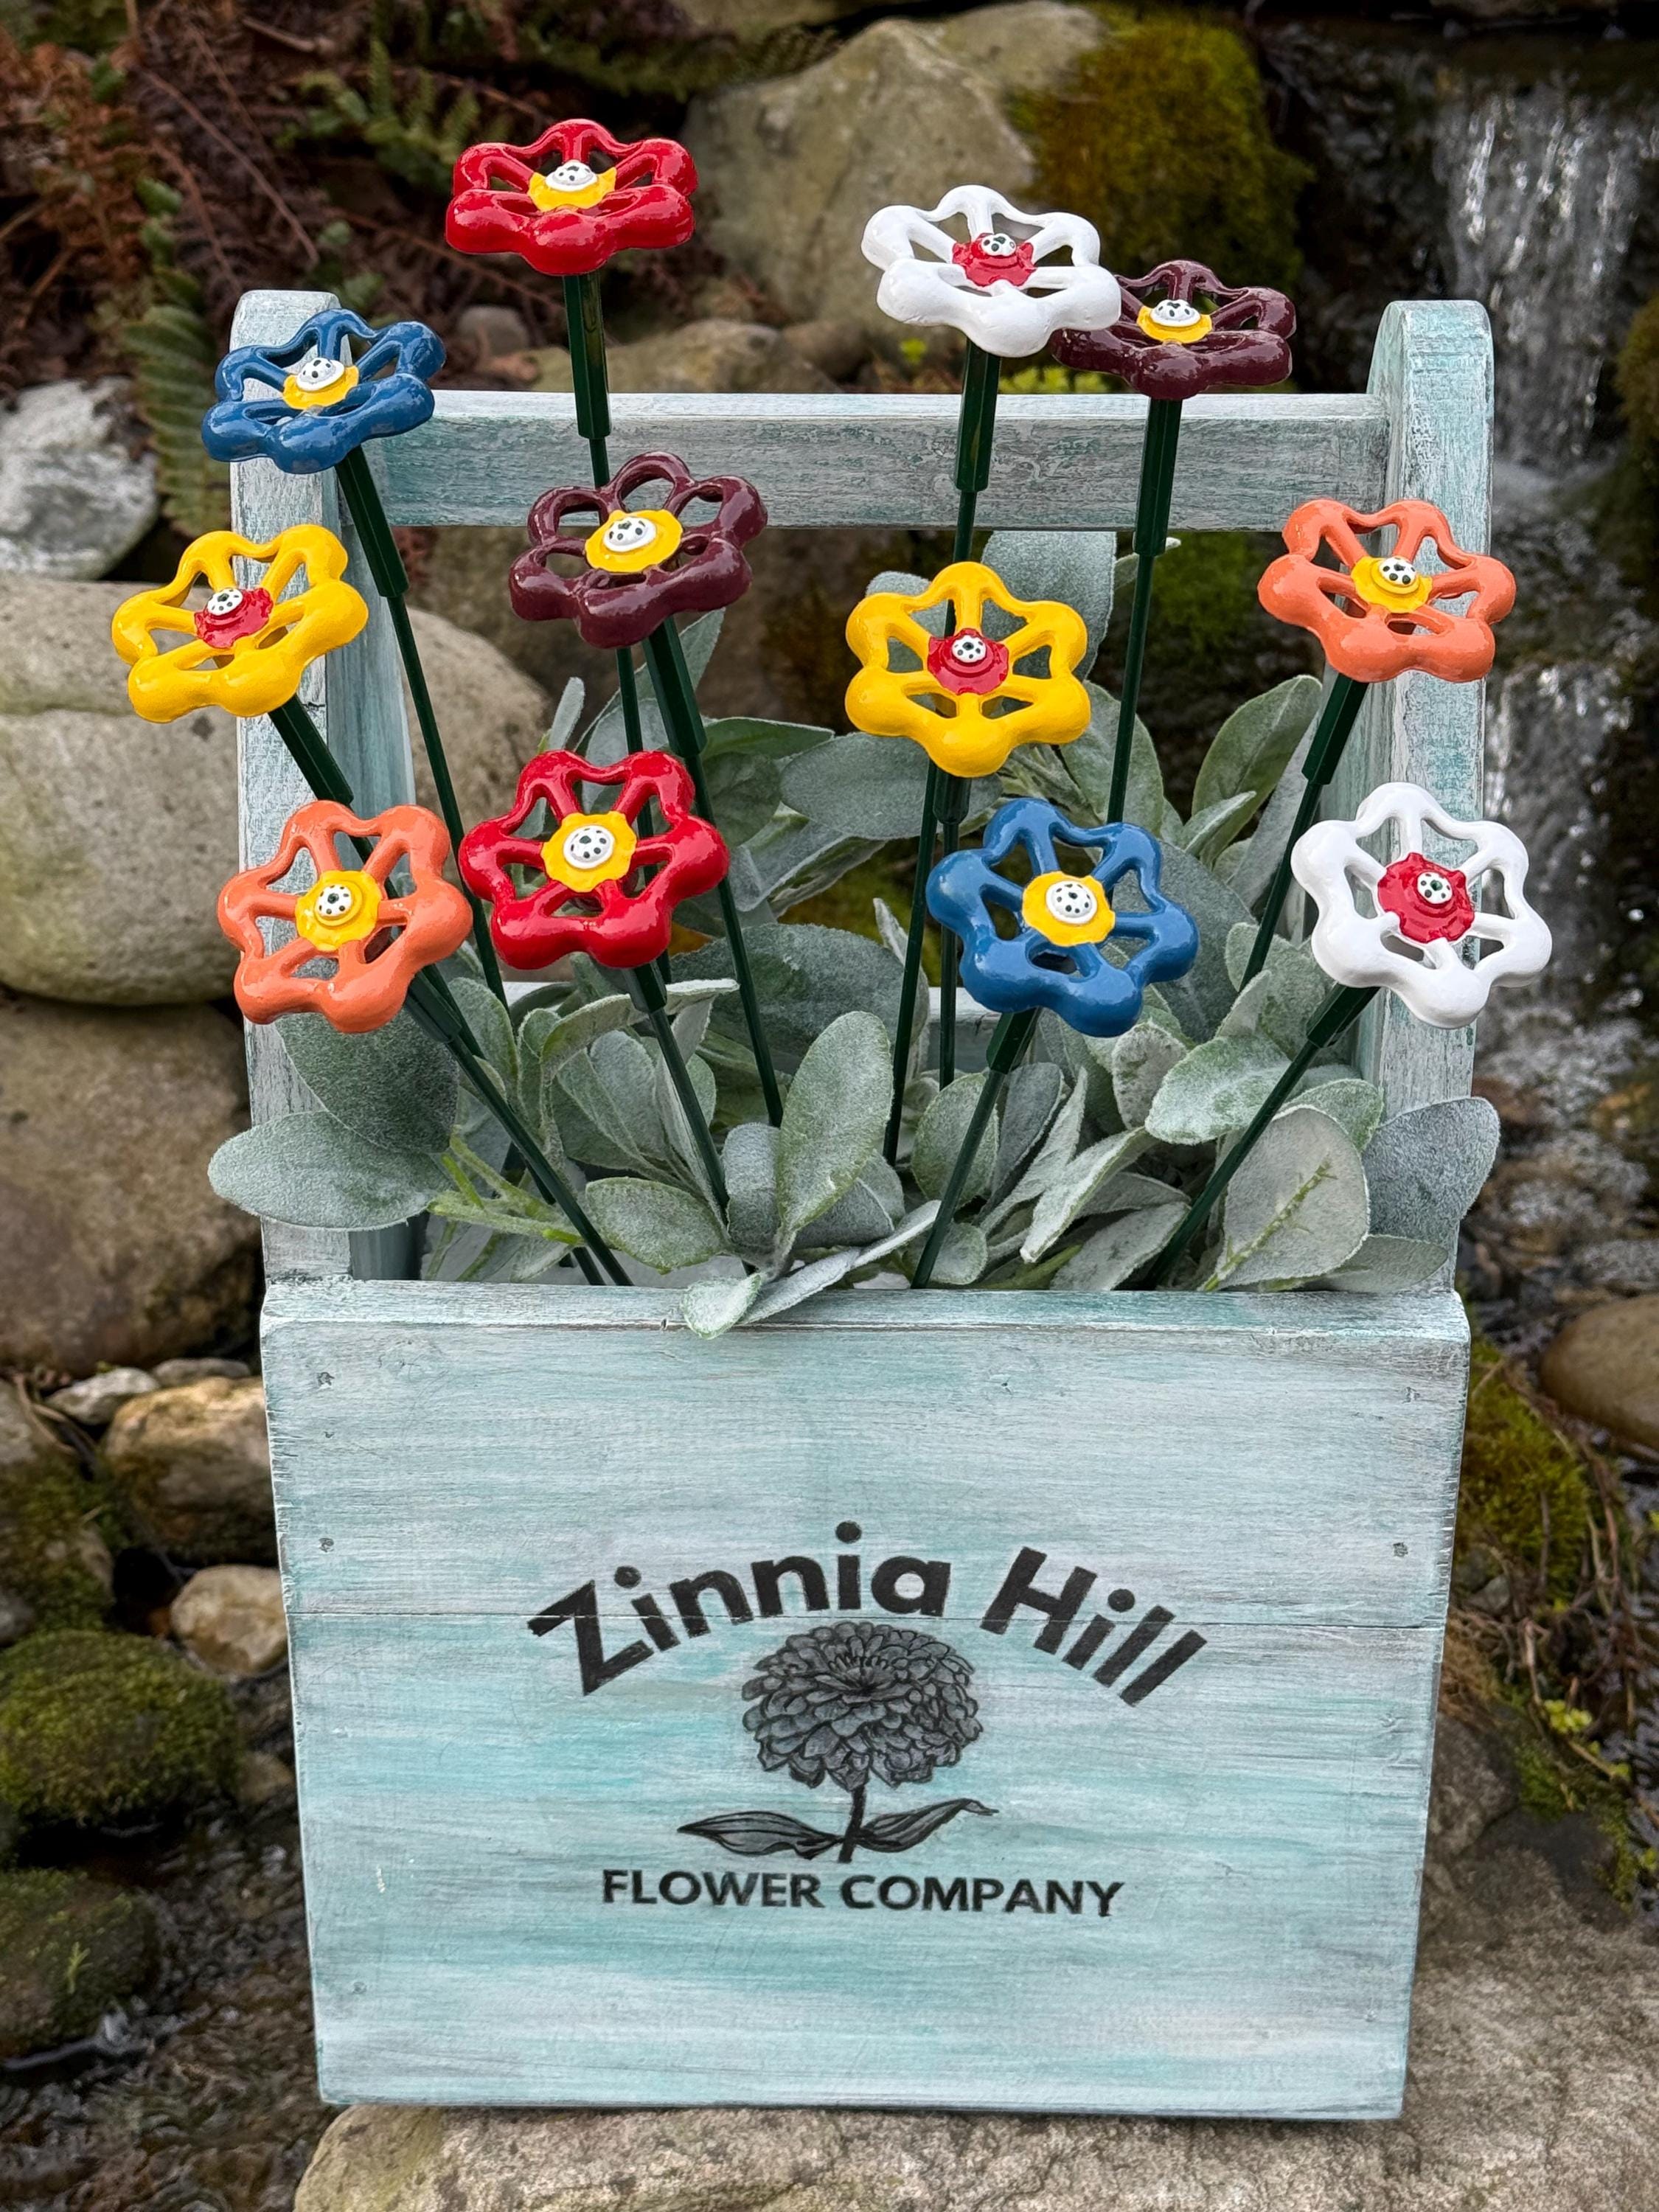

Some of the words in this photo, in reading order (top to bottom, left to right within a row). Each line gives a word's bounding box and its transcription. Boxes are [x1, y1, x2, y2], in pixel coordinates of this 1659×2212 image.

[527, 1520, 951, 1696] Zinnia
[980, 1545, 1208, 1708] Hill
[602, 1868, 825, 1908] FLOWER
[840, 1873, 1124, 1917] COMPANY
